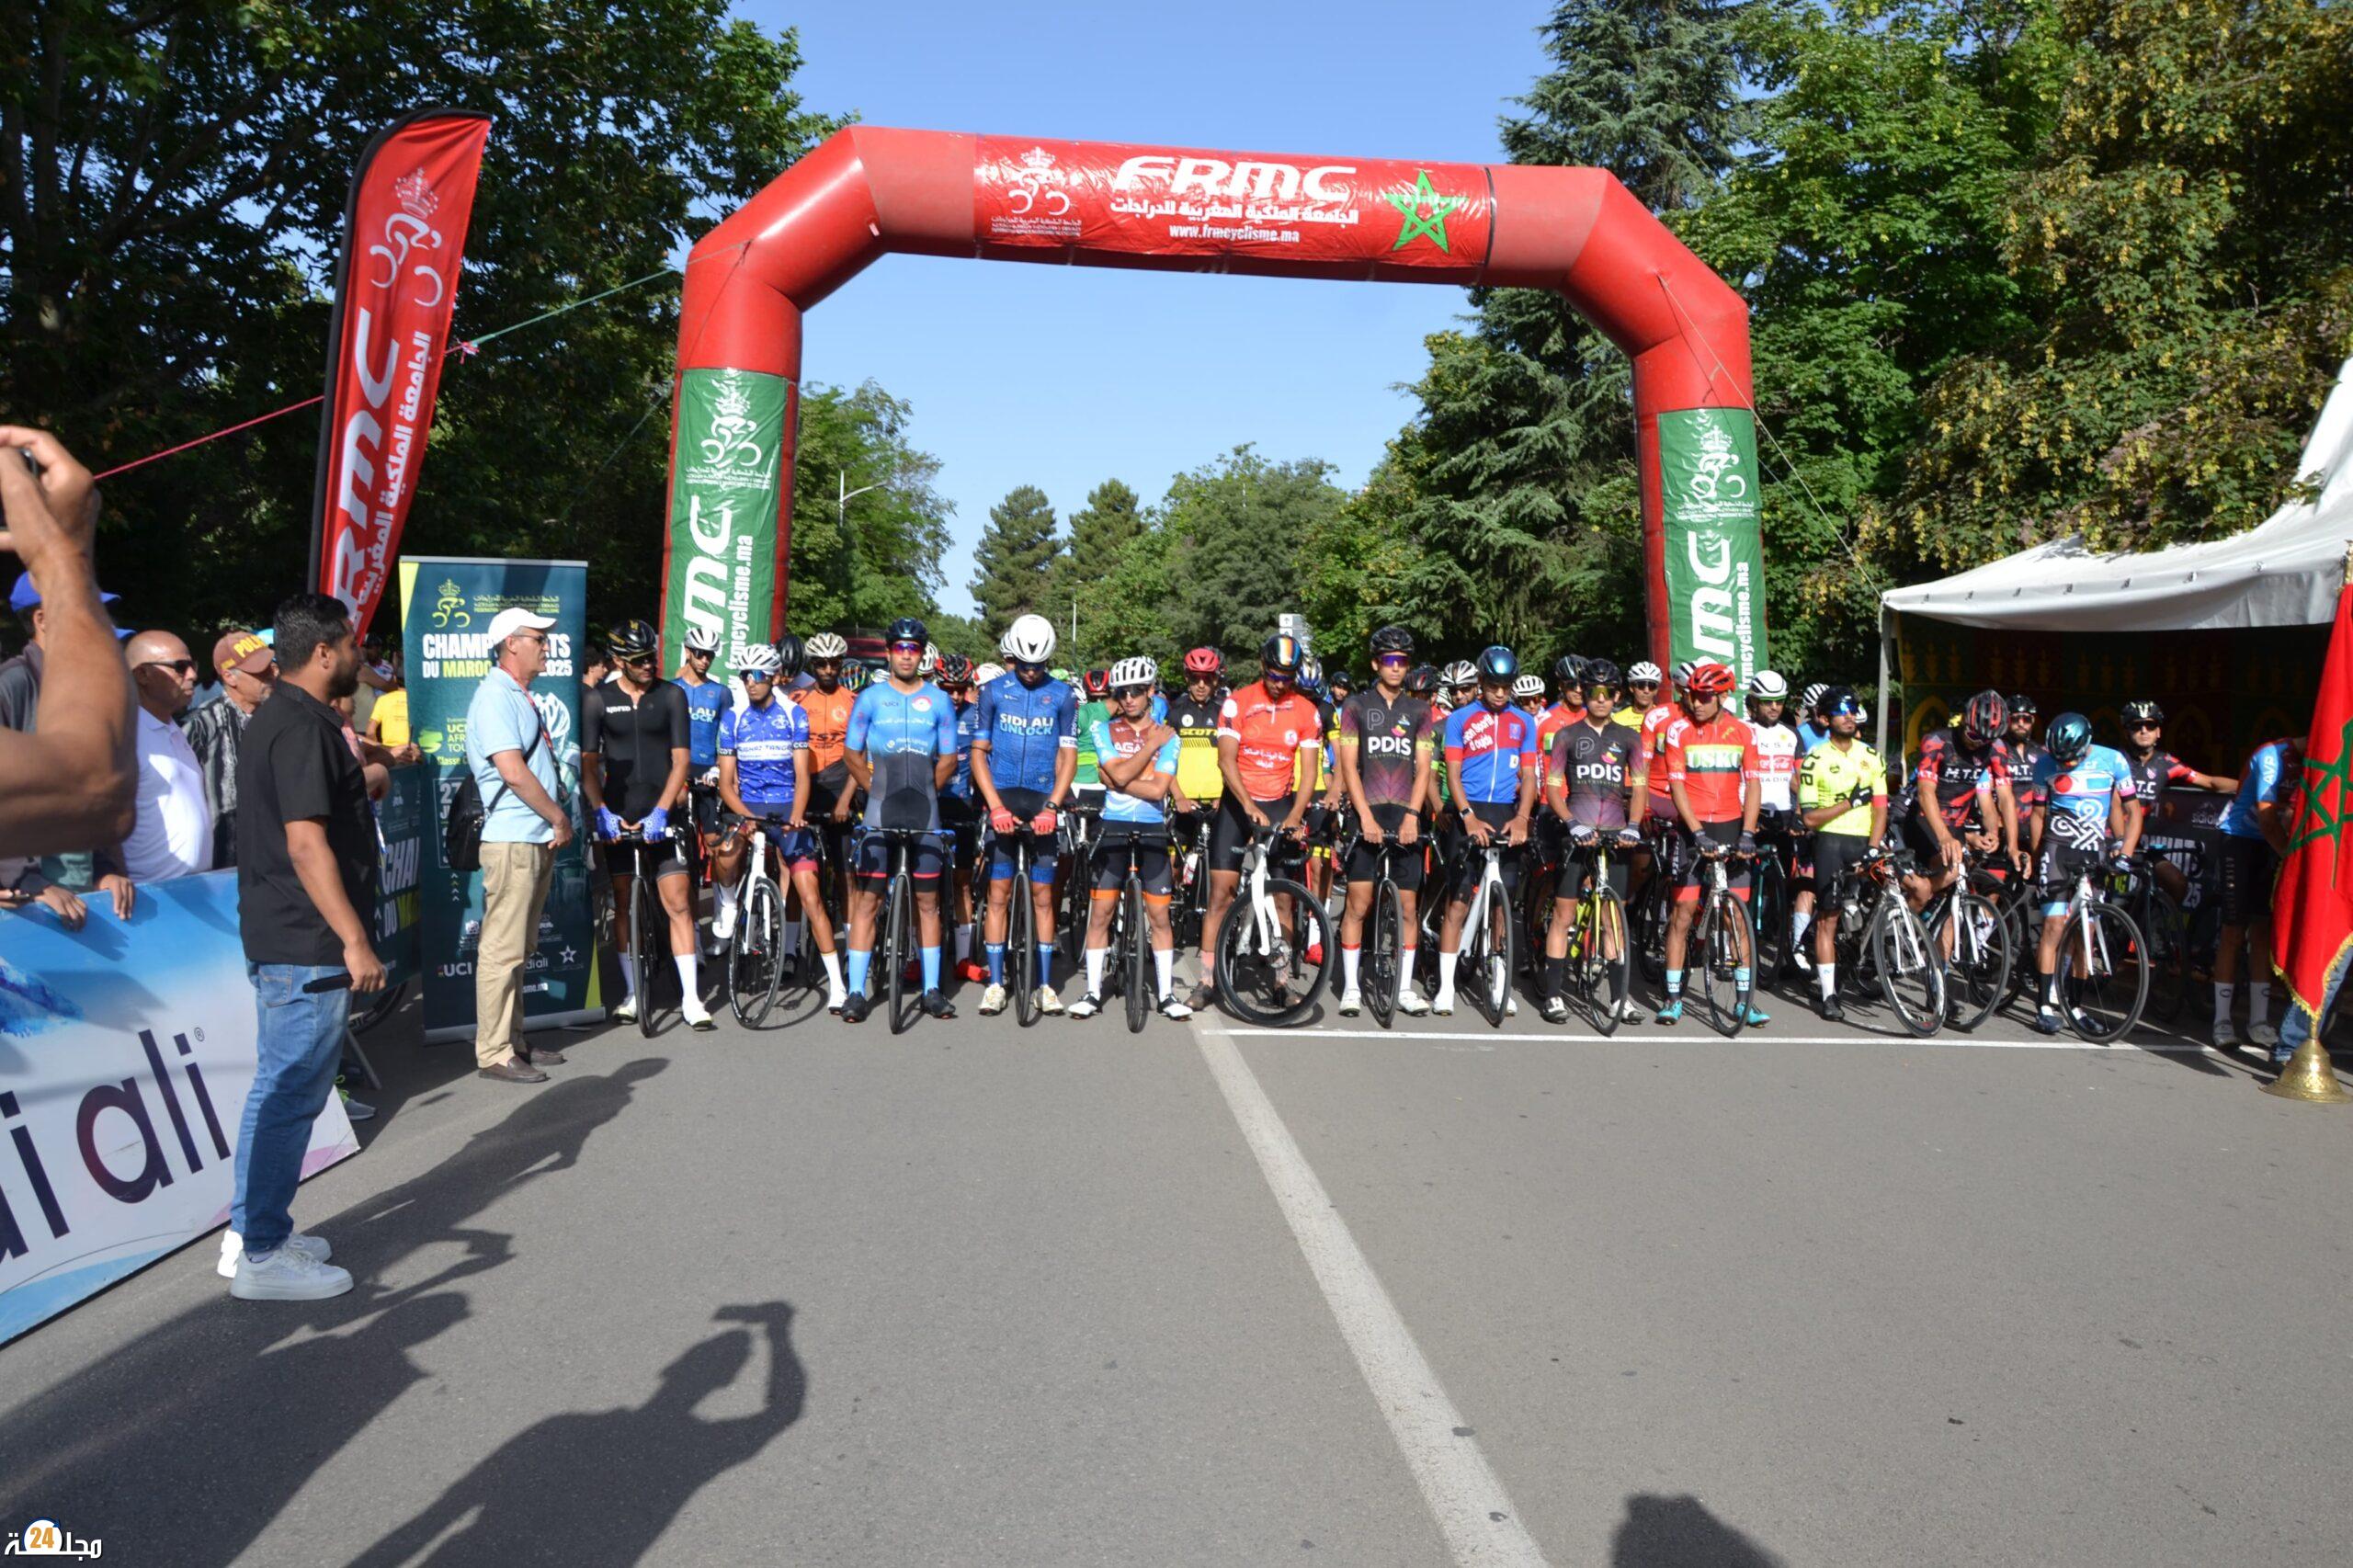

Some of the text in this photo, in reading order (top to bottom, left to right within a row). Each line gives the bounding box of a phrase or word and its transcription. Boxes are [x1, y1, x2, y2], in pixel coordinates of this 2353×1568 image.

[1113, 155, 1357, 201] FRMC
[1110, 197, 1359, 228] الجامعة الملكية المغربية للدراجات
[1169, 223, 1300, 243] www.frmcyclisme.ma
[333, 307, 400, 625] RMC
[422, 633, 571, 659] CHAMPTS
[422, 661, 439, 678] DU
[1000, 712, 1053, 728] SIDI ALI
[1000, 722, 1052, 736] UNLOCK
[1368, 735, 1411, 756] PDIS
[1576, 763, 1622, 782] PDIS
[444, 962, 472, 977] UCI
[76, 1028, 231, 1204] ali
